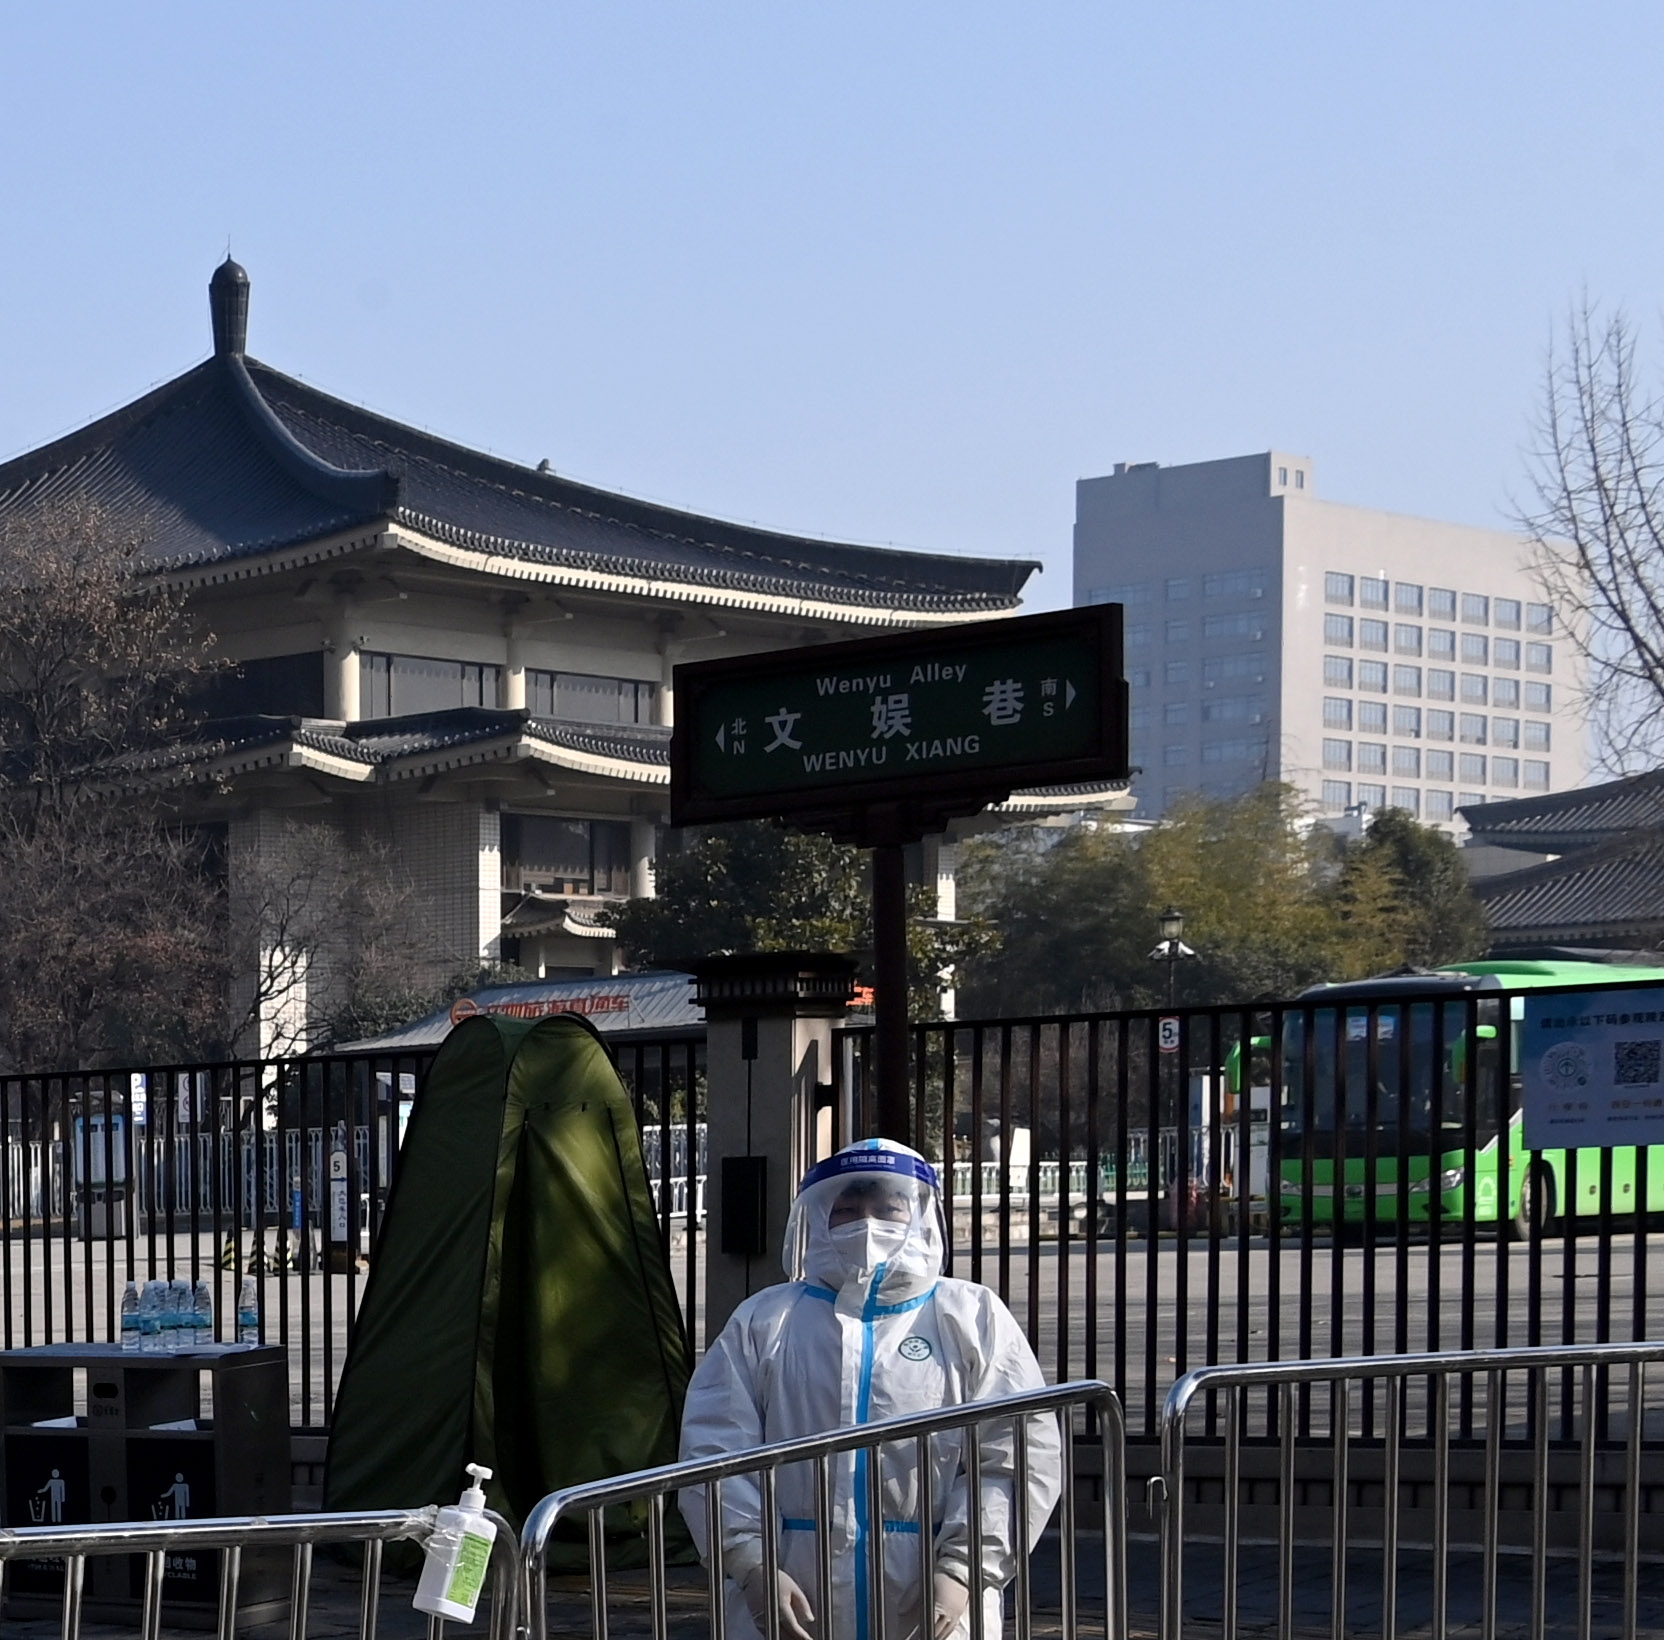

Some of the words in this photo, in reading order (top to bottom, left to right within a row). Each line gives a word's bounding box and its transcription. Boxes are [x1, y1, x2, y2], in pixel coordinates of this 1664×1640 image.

[816, 672, 892, 697] Wenyu
[910, 663, 967, 686] Alley
[1040, 677, 1058, 697] 南
[763, 679, 1025, 753] 文娱巷
[1043, 702, 1055, 717] S
[731, 718, 747, 737] 北
[733, 740, 746, 755] N
[803, 746, 888, 773] WENYU
[905, 735, 981, 762] XIANG
[333, 1161, 340, 1172] 5
